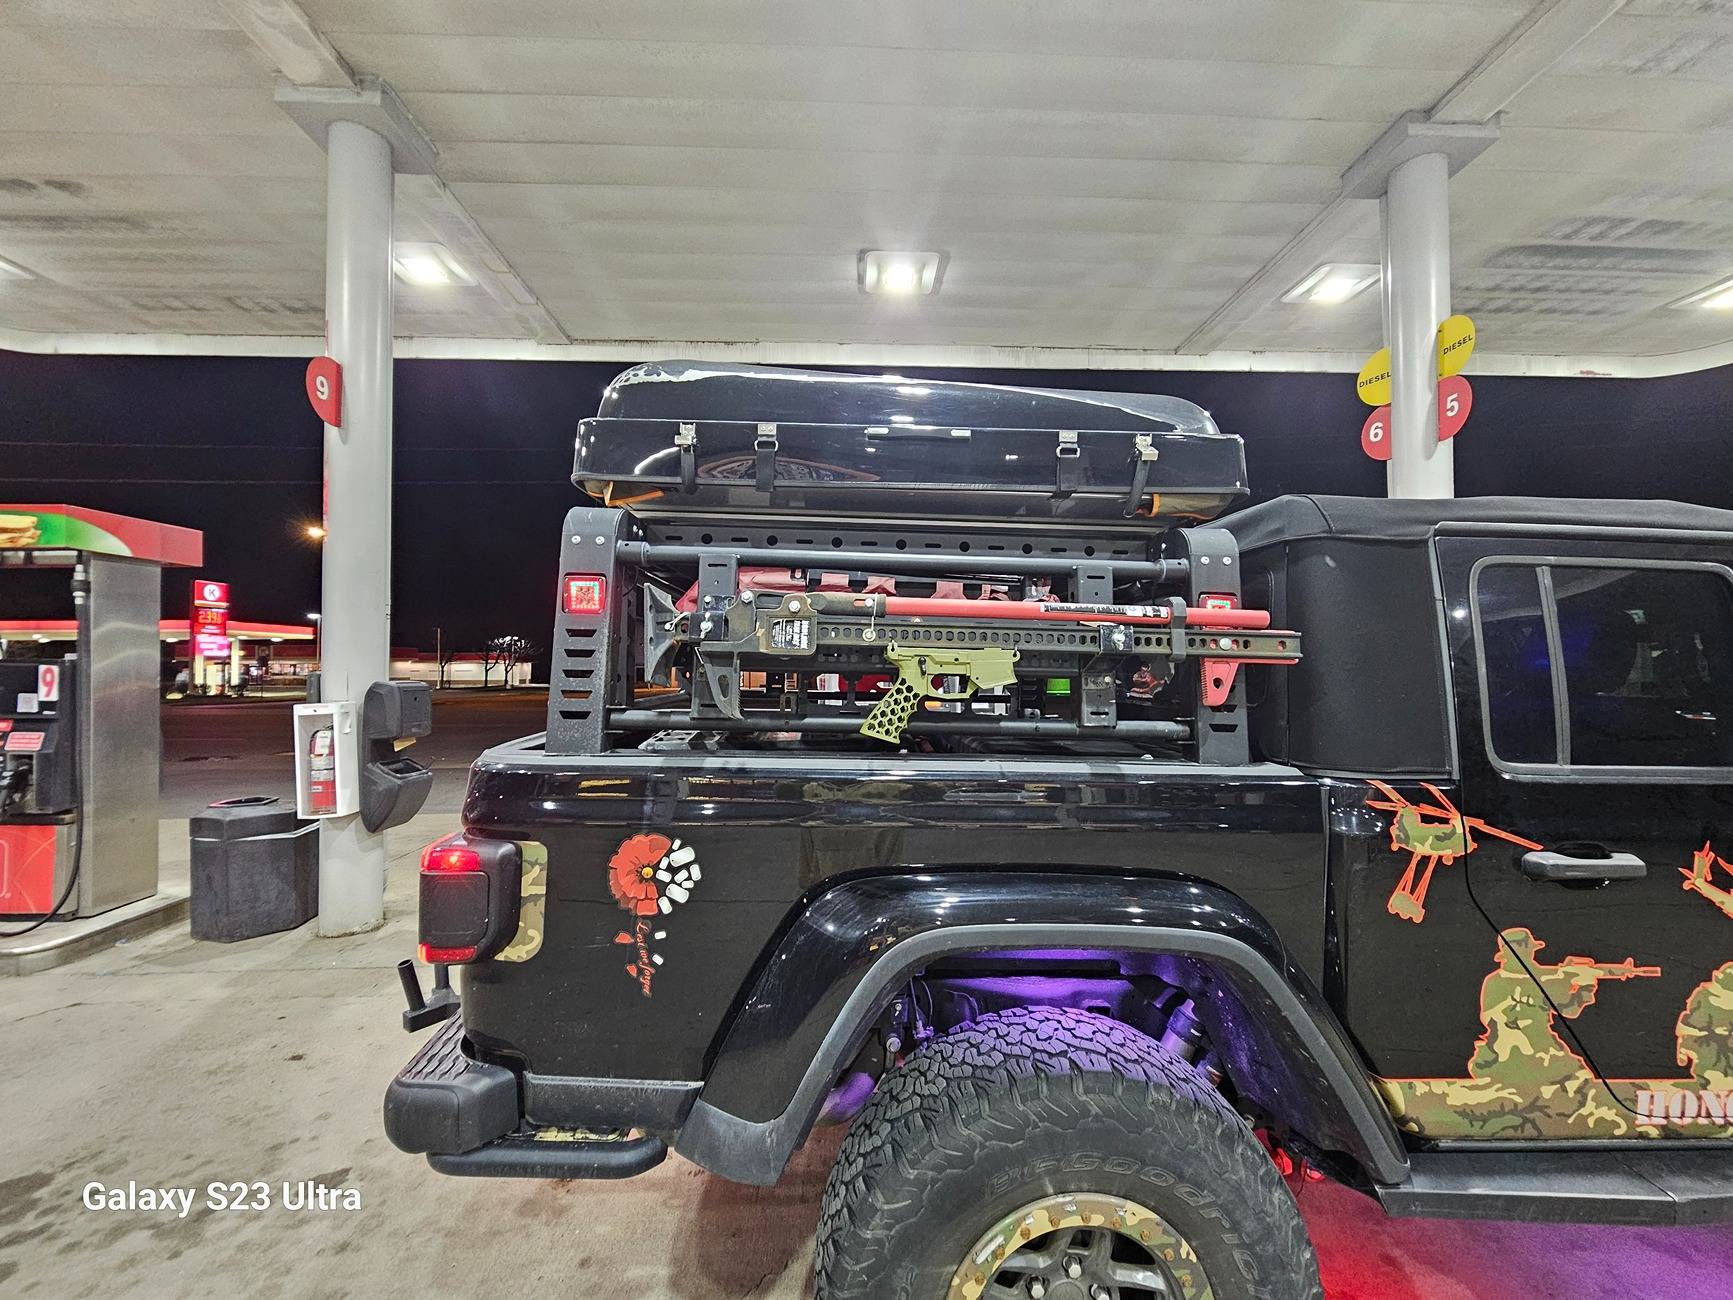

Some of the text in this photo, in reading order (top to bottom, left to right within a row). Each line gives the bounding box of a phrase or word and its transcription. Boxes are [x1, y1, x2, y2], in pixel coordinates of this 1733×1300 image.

[1443, 334, 1473, 355] DIESEL
[315, 375, 329, 400] 9
[1359, 371, 1392, 388] DIESEL
[1446, 393, 1459, 417] 5
[1369, 422, 1384, 442] 6
[42, 667, 55, 698] 9
[1634, 1088, 1733, 1125] HON
